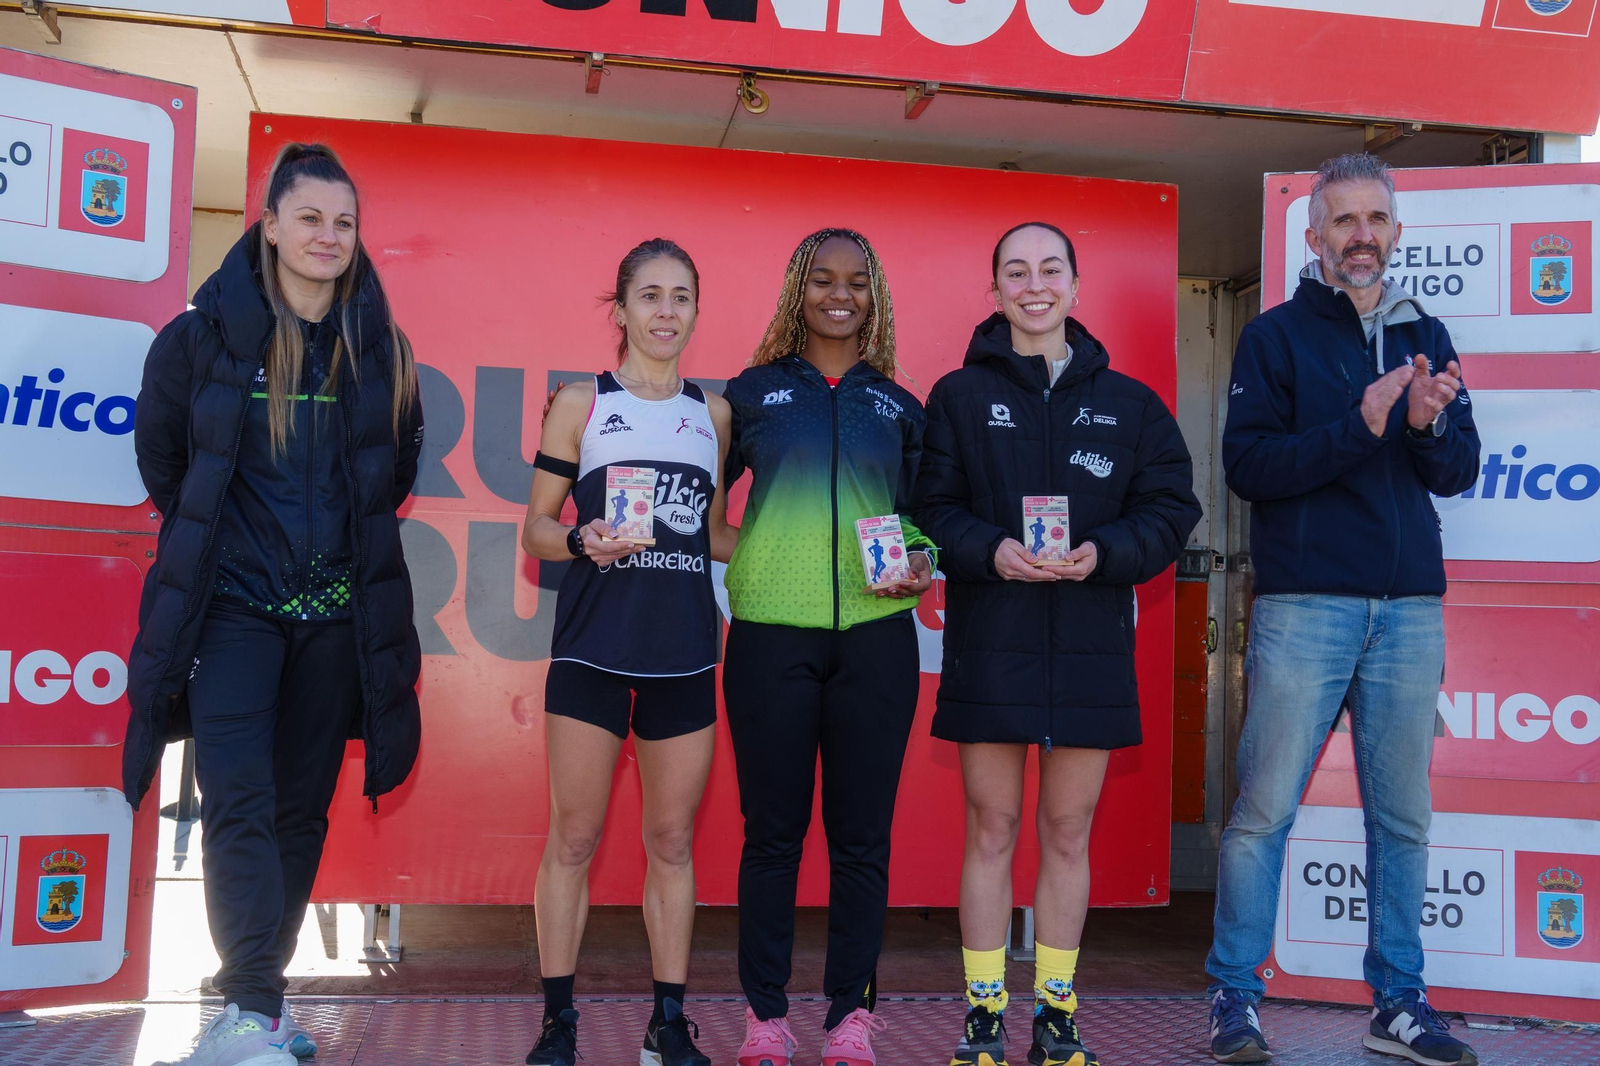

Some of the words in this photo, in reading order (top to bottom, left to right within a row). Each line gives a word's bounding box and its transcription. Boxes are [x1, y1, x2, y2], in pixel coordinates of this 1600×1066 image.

[0, 367, 136, 436] tico
[763, 388, 794, 405] DK
[1093, 417, 1117, 426] DELIKIA
[1069, 450, 1114, 472] delikia
[1461, 444, 1600, 501] tico
[669, 510, 695, 525] fresh
[1324, 895, 1367, 922] DE
